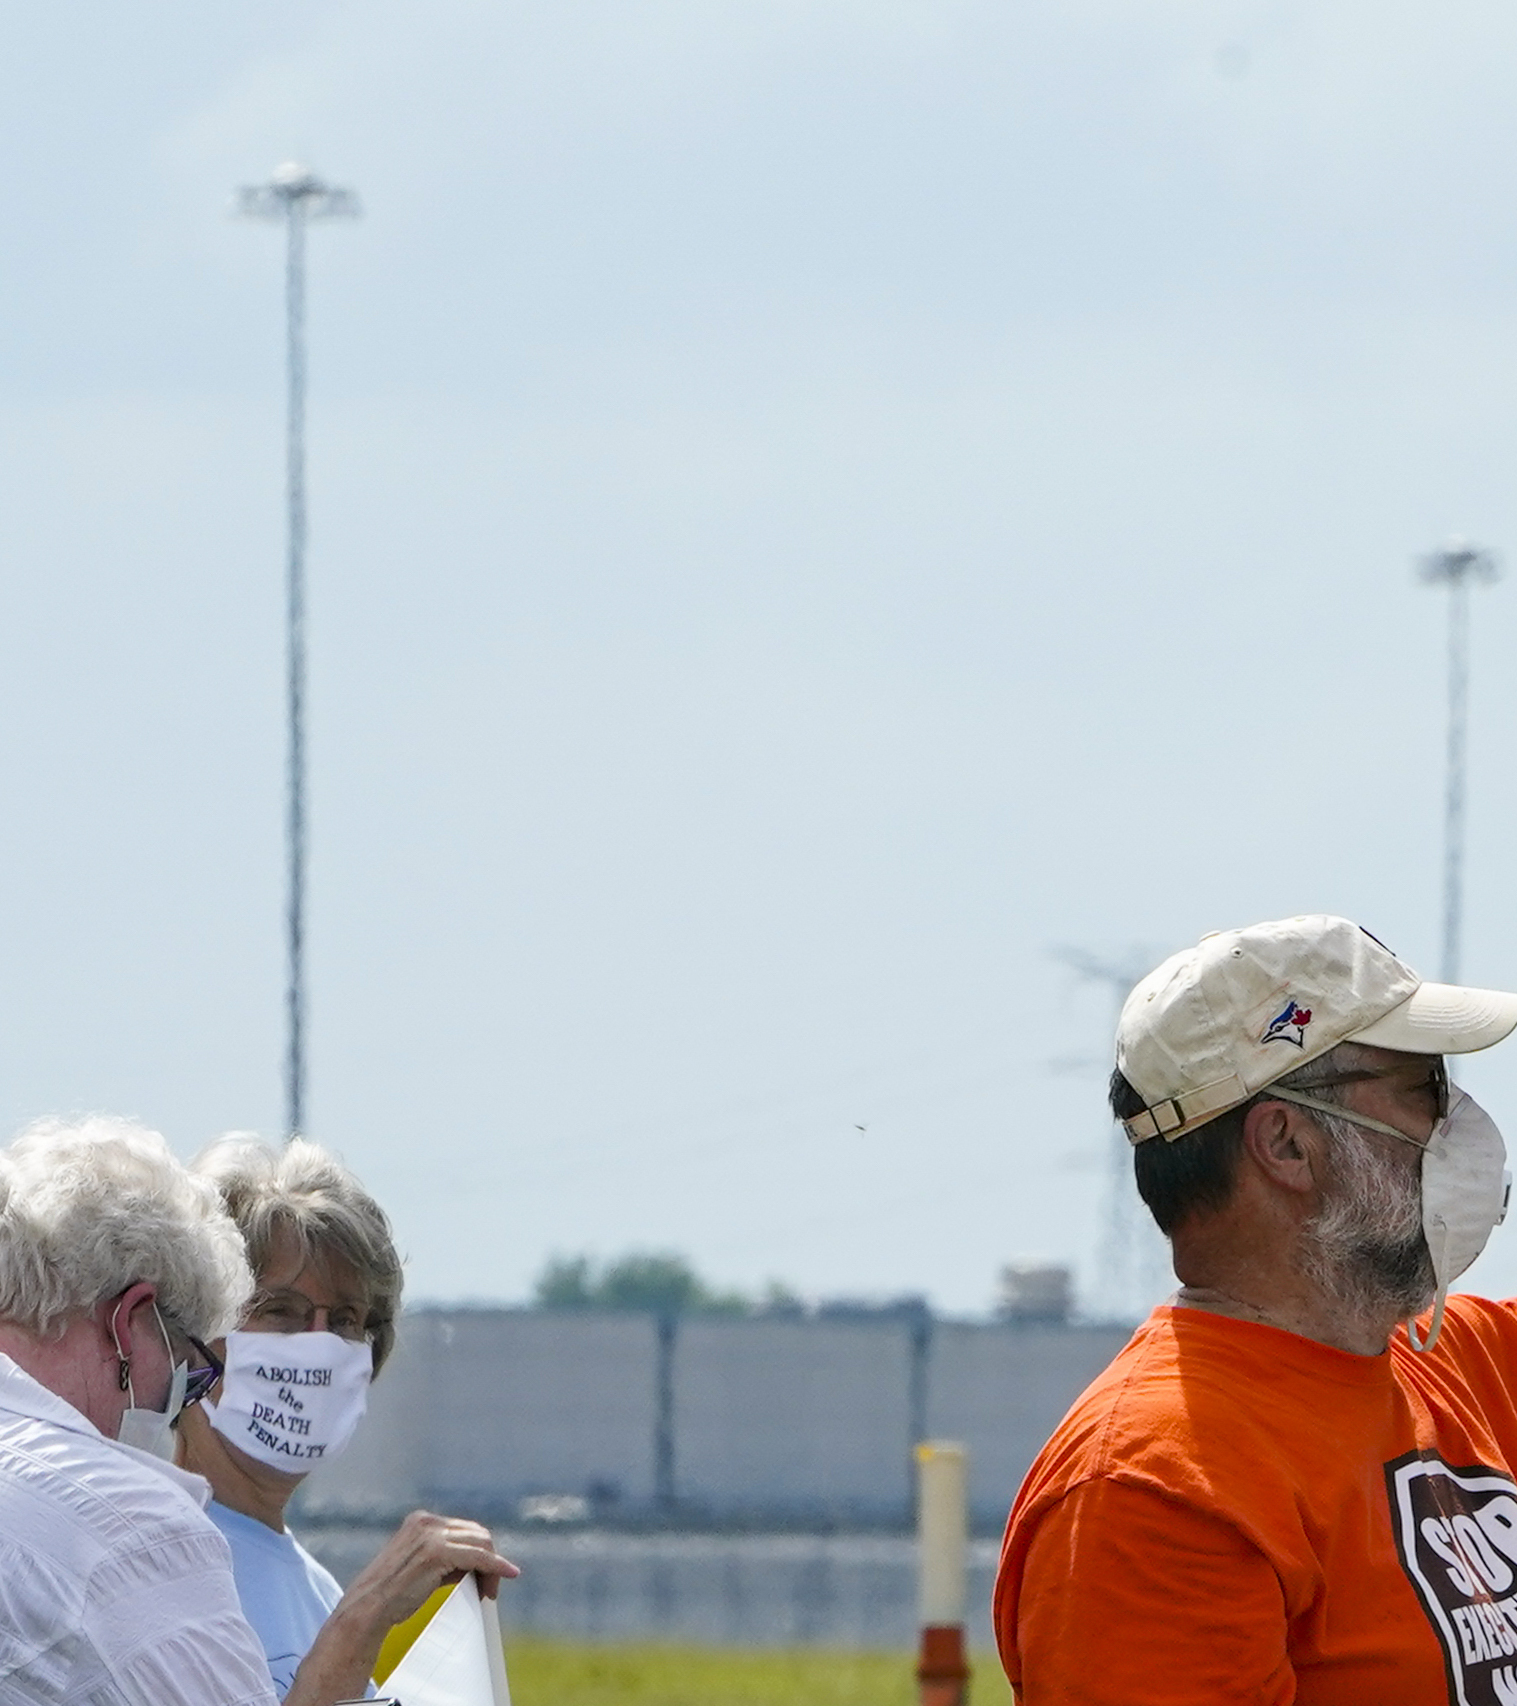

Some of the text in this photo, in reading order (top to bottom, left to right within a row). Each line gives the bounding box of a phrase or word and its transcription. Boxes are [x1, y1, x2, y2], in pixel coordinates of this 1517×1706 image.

[255, 1365, 333, 1387] ABOLISH
[277, 1387, 304, 1413] the
[251, 1402, 312, 1435] DEATH
[247, 1418, 328, 1458] PENALTY
